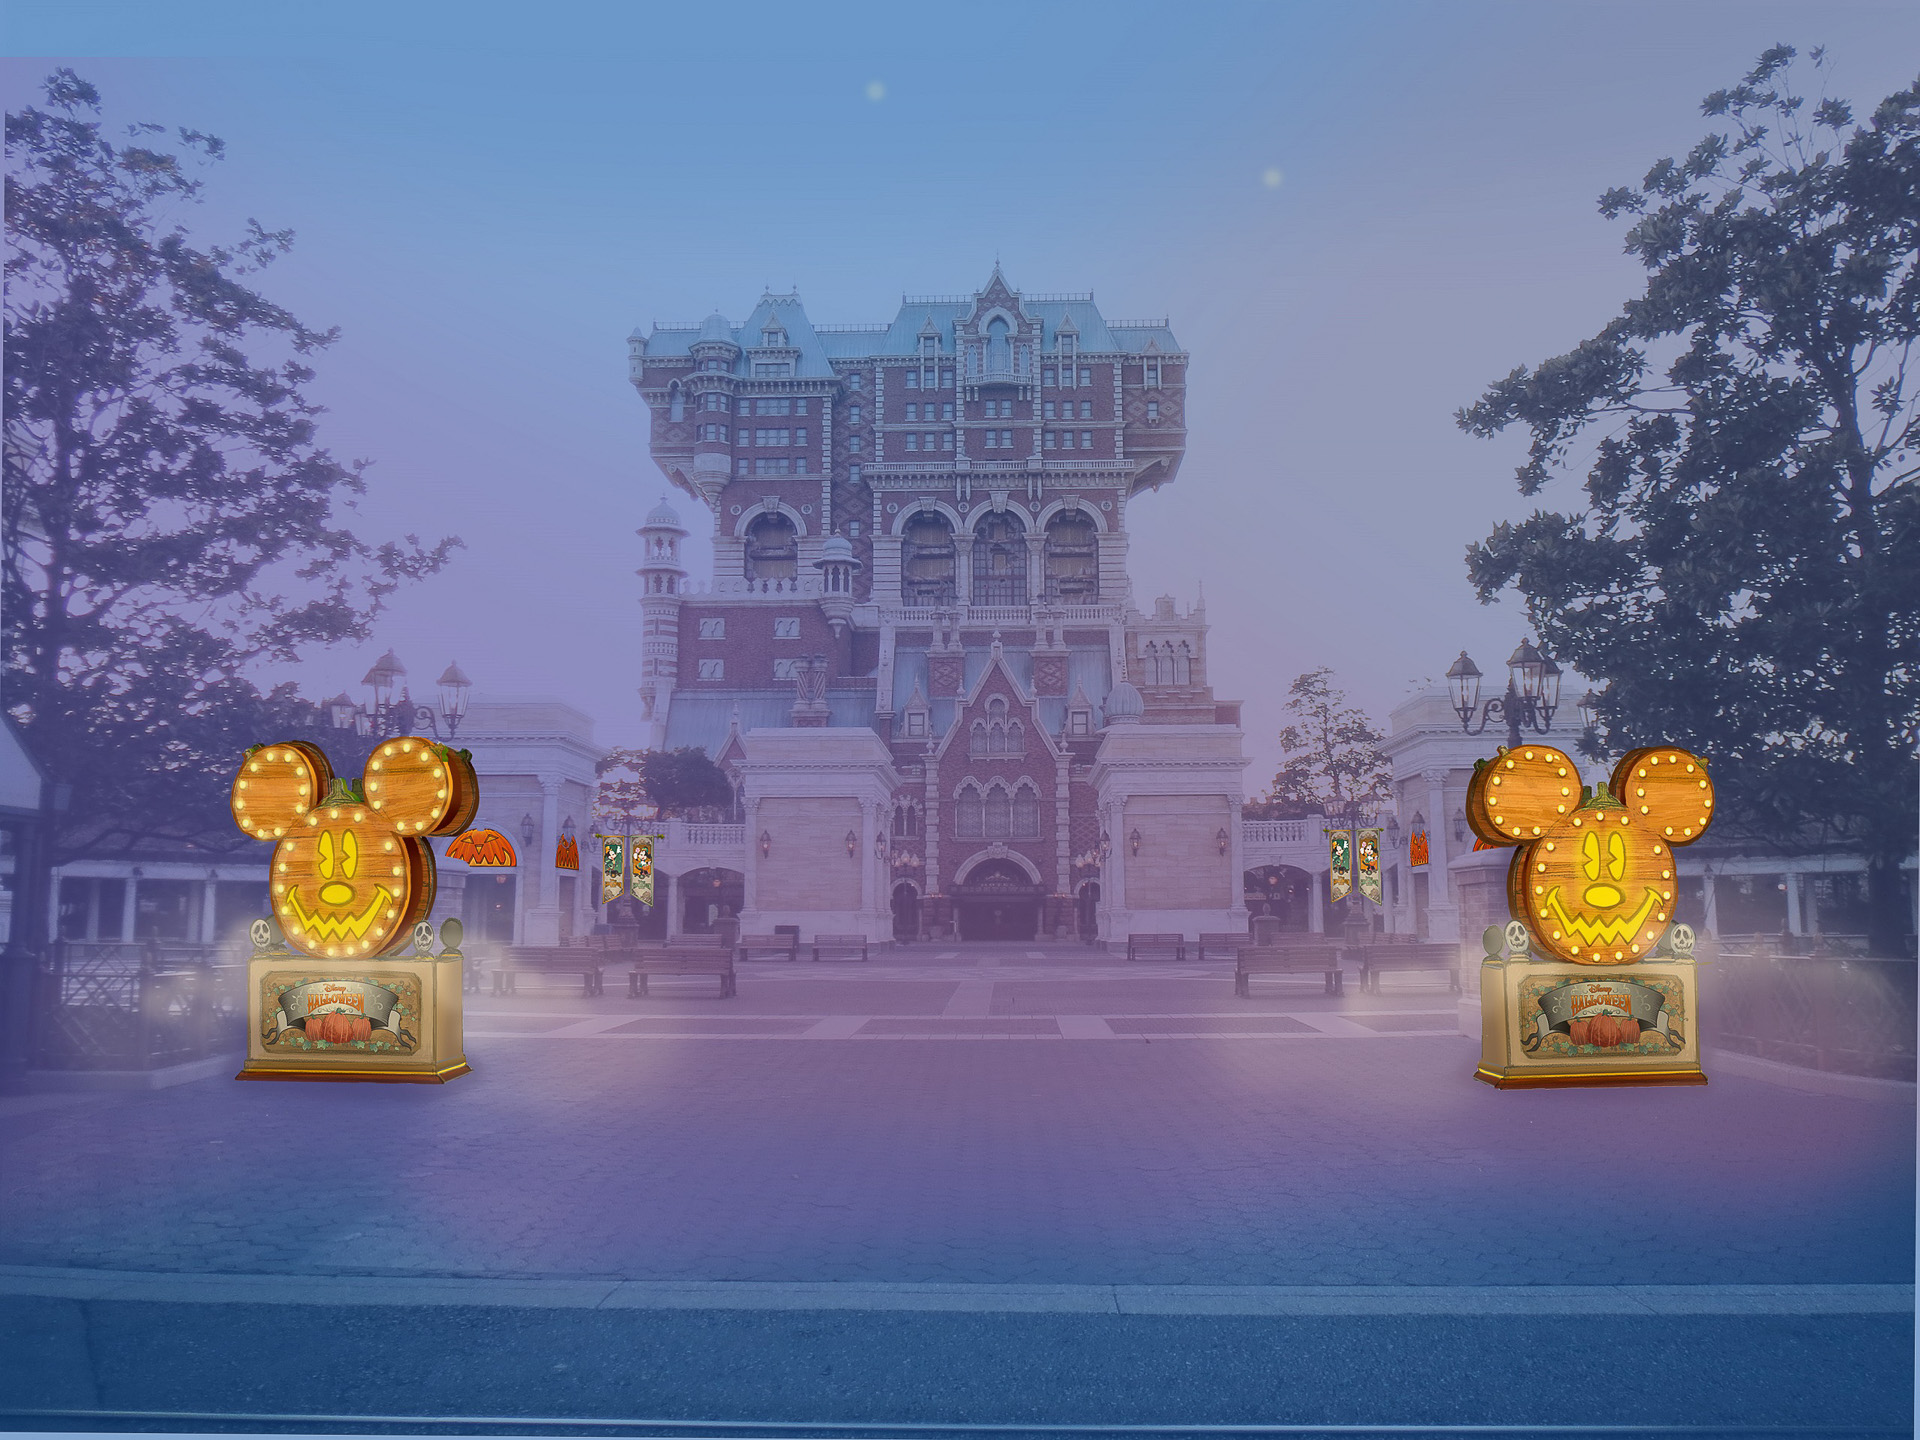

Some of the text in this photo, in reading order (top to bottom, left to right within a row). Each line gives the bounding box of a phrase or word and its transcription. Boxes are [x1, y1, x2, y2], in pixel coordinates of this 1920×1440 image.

[323, 983, 346, 994] Disney
[1587, 984, 1612, 995] Disney
[307, 993, 365, 1014] HALLOWEEN
[1571, 994, 1632, 1017] HALLOWEEN
